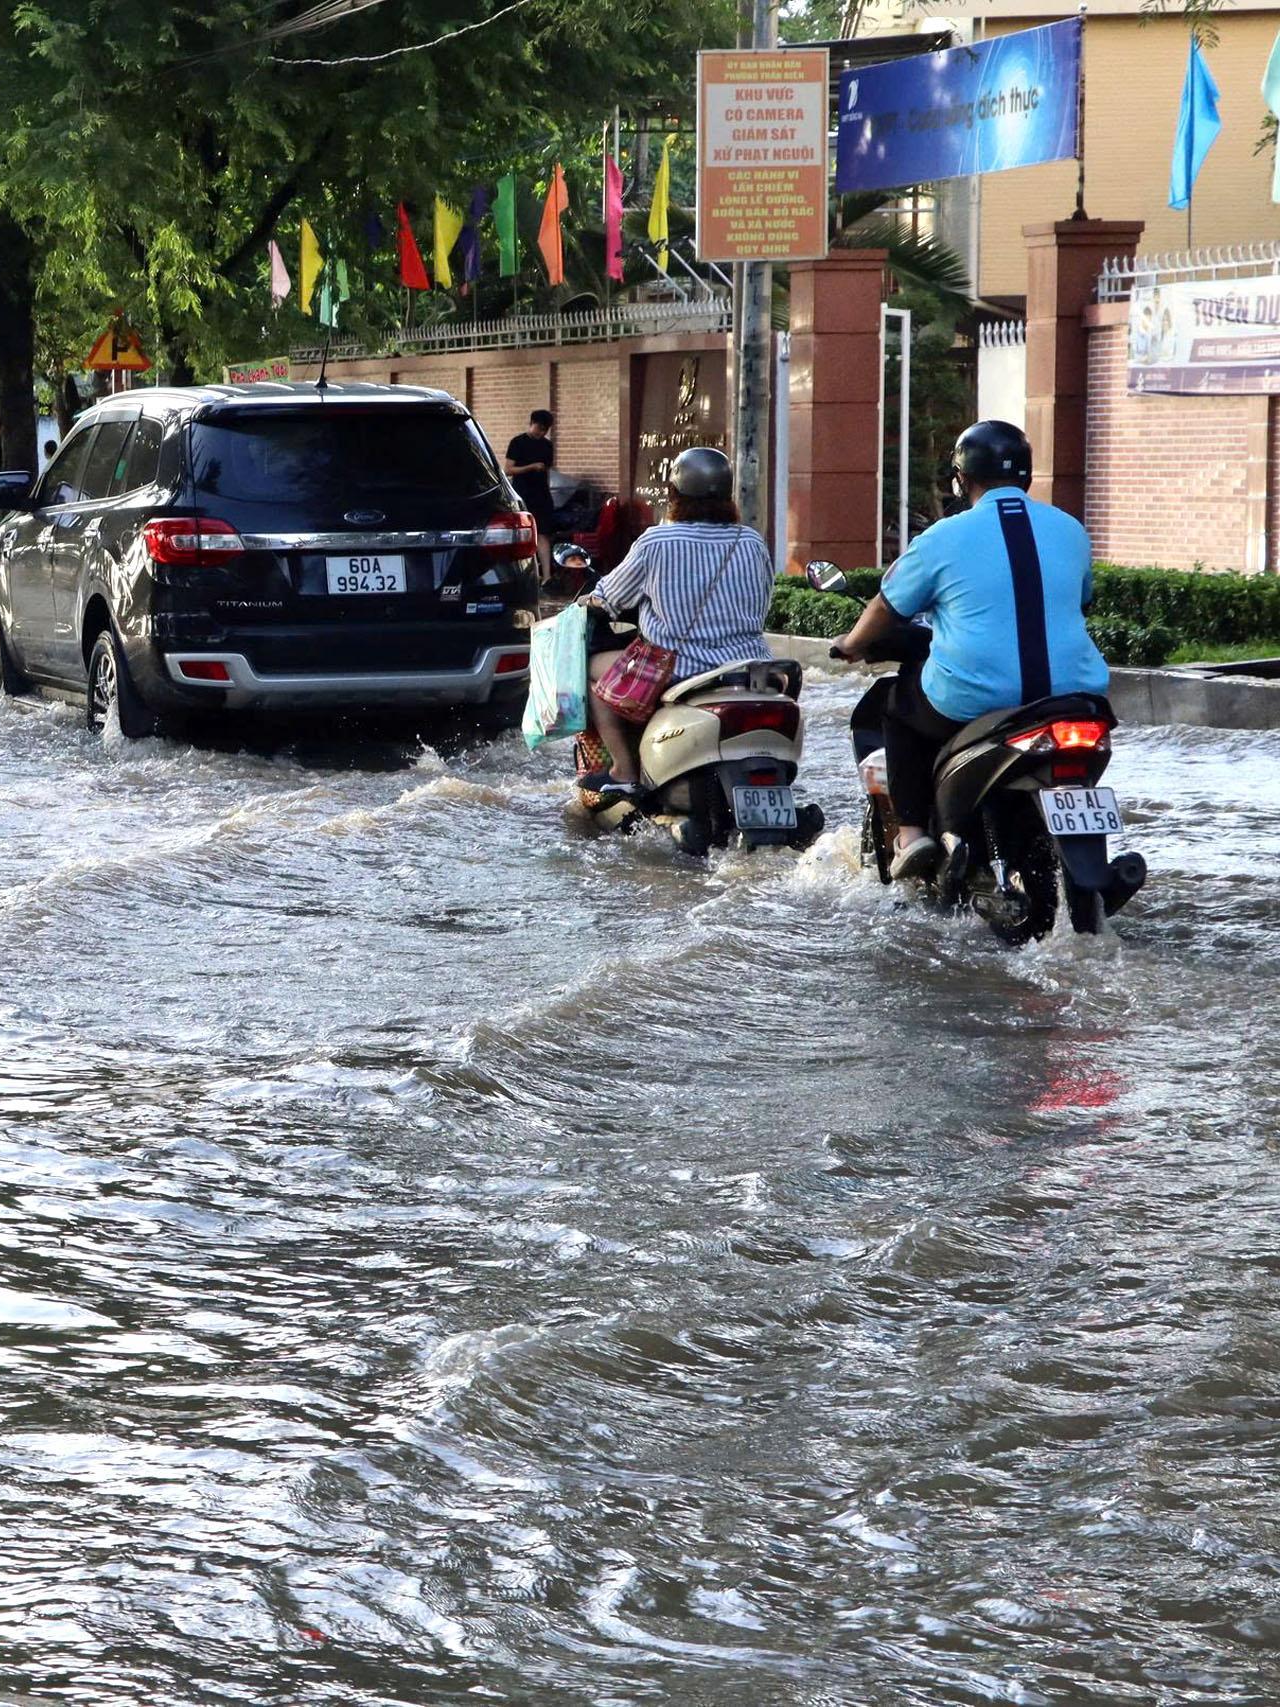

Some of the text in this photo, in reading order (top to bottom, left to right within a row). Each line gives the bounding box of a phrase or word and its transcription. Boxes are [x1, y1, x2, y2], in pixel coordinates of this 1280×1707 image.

[735, 86, 794, 102] KHU VỰC
[978, 90, 1006, 120] đích
[1009, 87, 1040, 119] thực
[725, 105, 805, 122] CÓ CAMERA
[732, 126, 797, 141] GIÁM SÁT
[713, 145, 815, 163] XỬ PHẠT NGUỘI
[728, 169, 800, 181] CÁC HÀNH VI
[756, 181, 795, 193] CHIẾM
[791, 206, 815, 216] RÁC
[730, 218, 746, 229] VÀ
[765, 218, 796, 229] NƯỚC
[726, 230, 765, 242] KHÔNG
[1192, 288, 1249, 326] TUYỂN
[349, 557, 382, 574] 60A
[337, 575, 397, 592] 994.32
[216, 600, 284, 608] TITANIUM
[743, 790, 784, 807] 60-B1
[1053, 790, 1107, 810] 60-AL
[1051, 811, 1119, 831] 061.58
